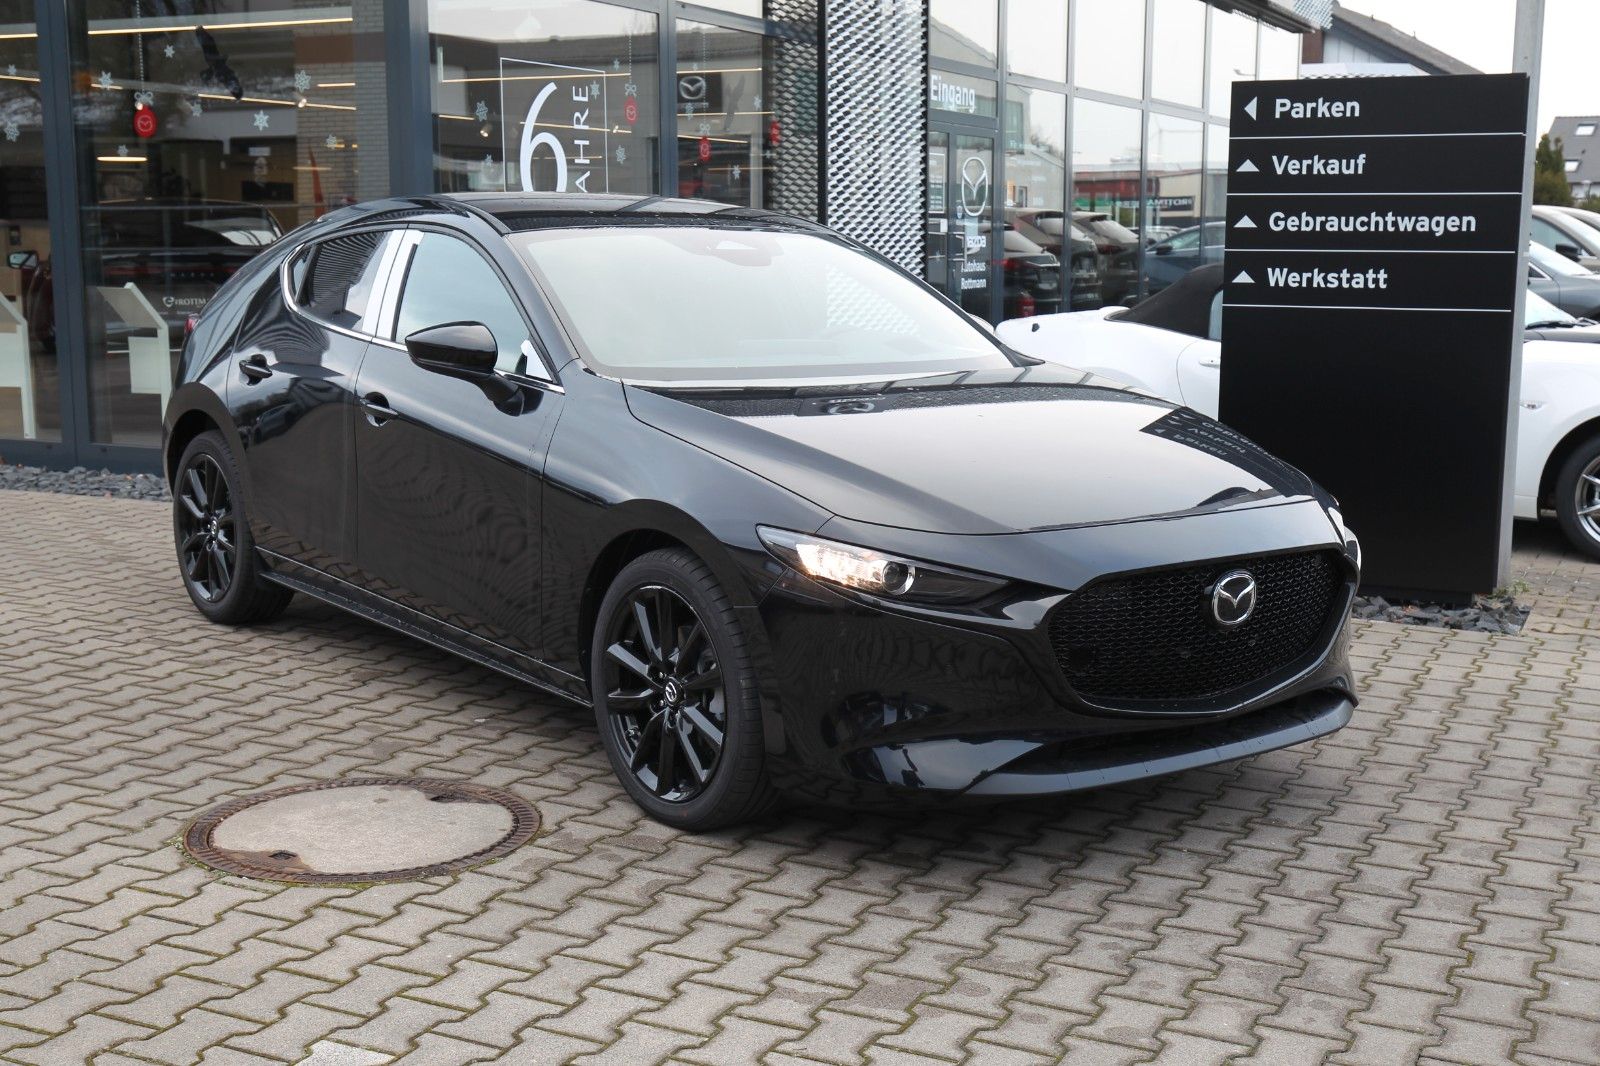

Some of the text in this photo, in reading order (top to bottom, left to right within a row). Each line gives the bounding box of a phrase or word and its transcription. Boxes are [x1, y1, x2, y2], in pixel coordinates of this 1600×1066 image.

[930, 74, 976, 114] Eingang
[1274, 97, 1361, 119] Parken
[519, 81, 568, 192] 6
[572, 85, 591, 192] AHRE
[1271, 153, 1367, 175] Verkauf
[1268, 211, 1477, 237] Gebrauchtwagen
[1266, 267, 1388, 289] Werkstatt
